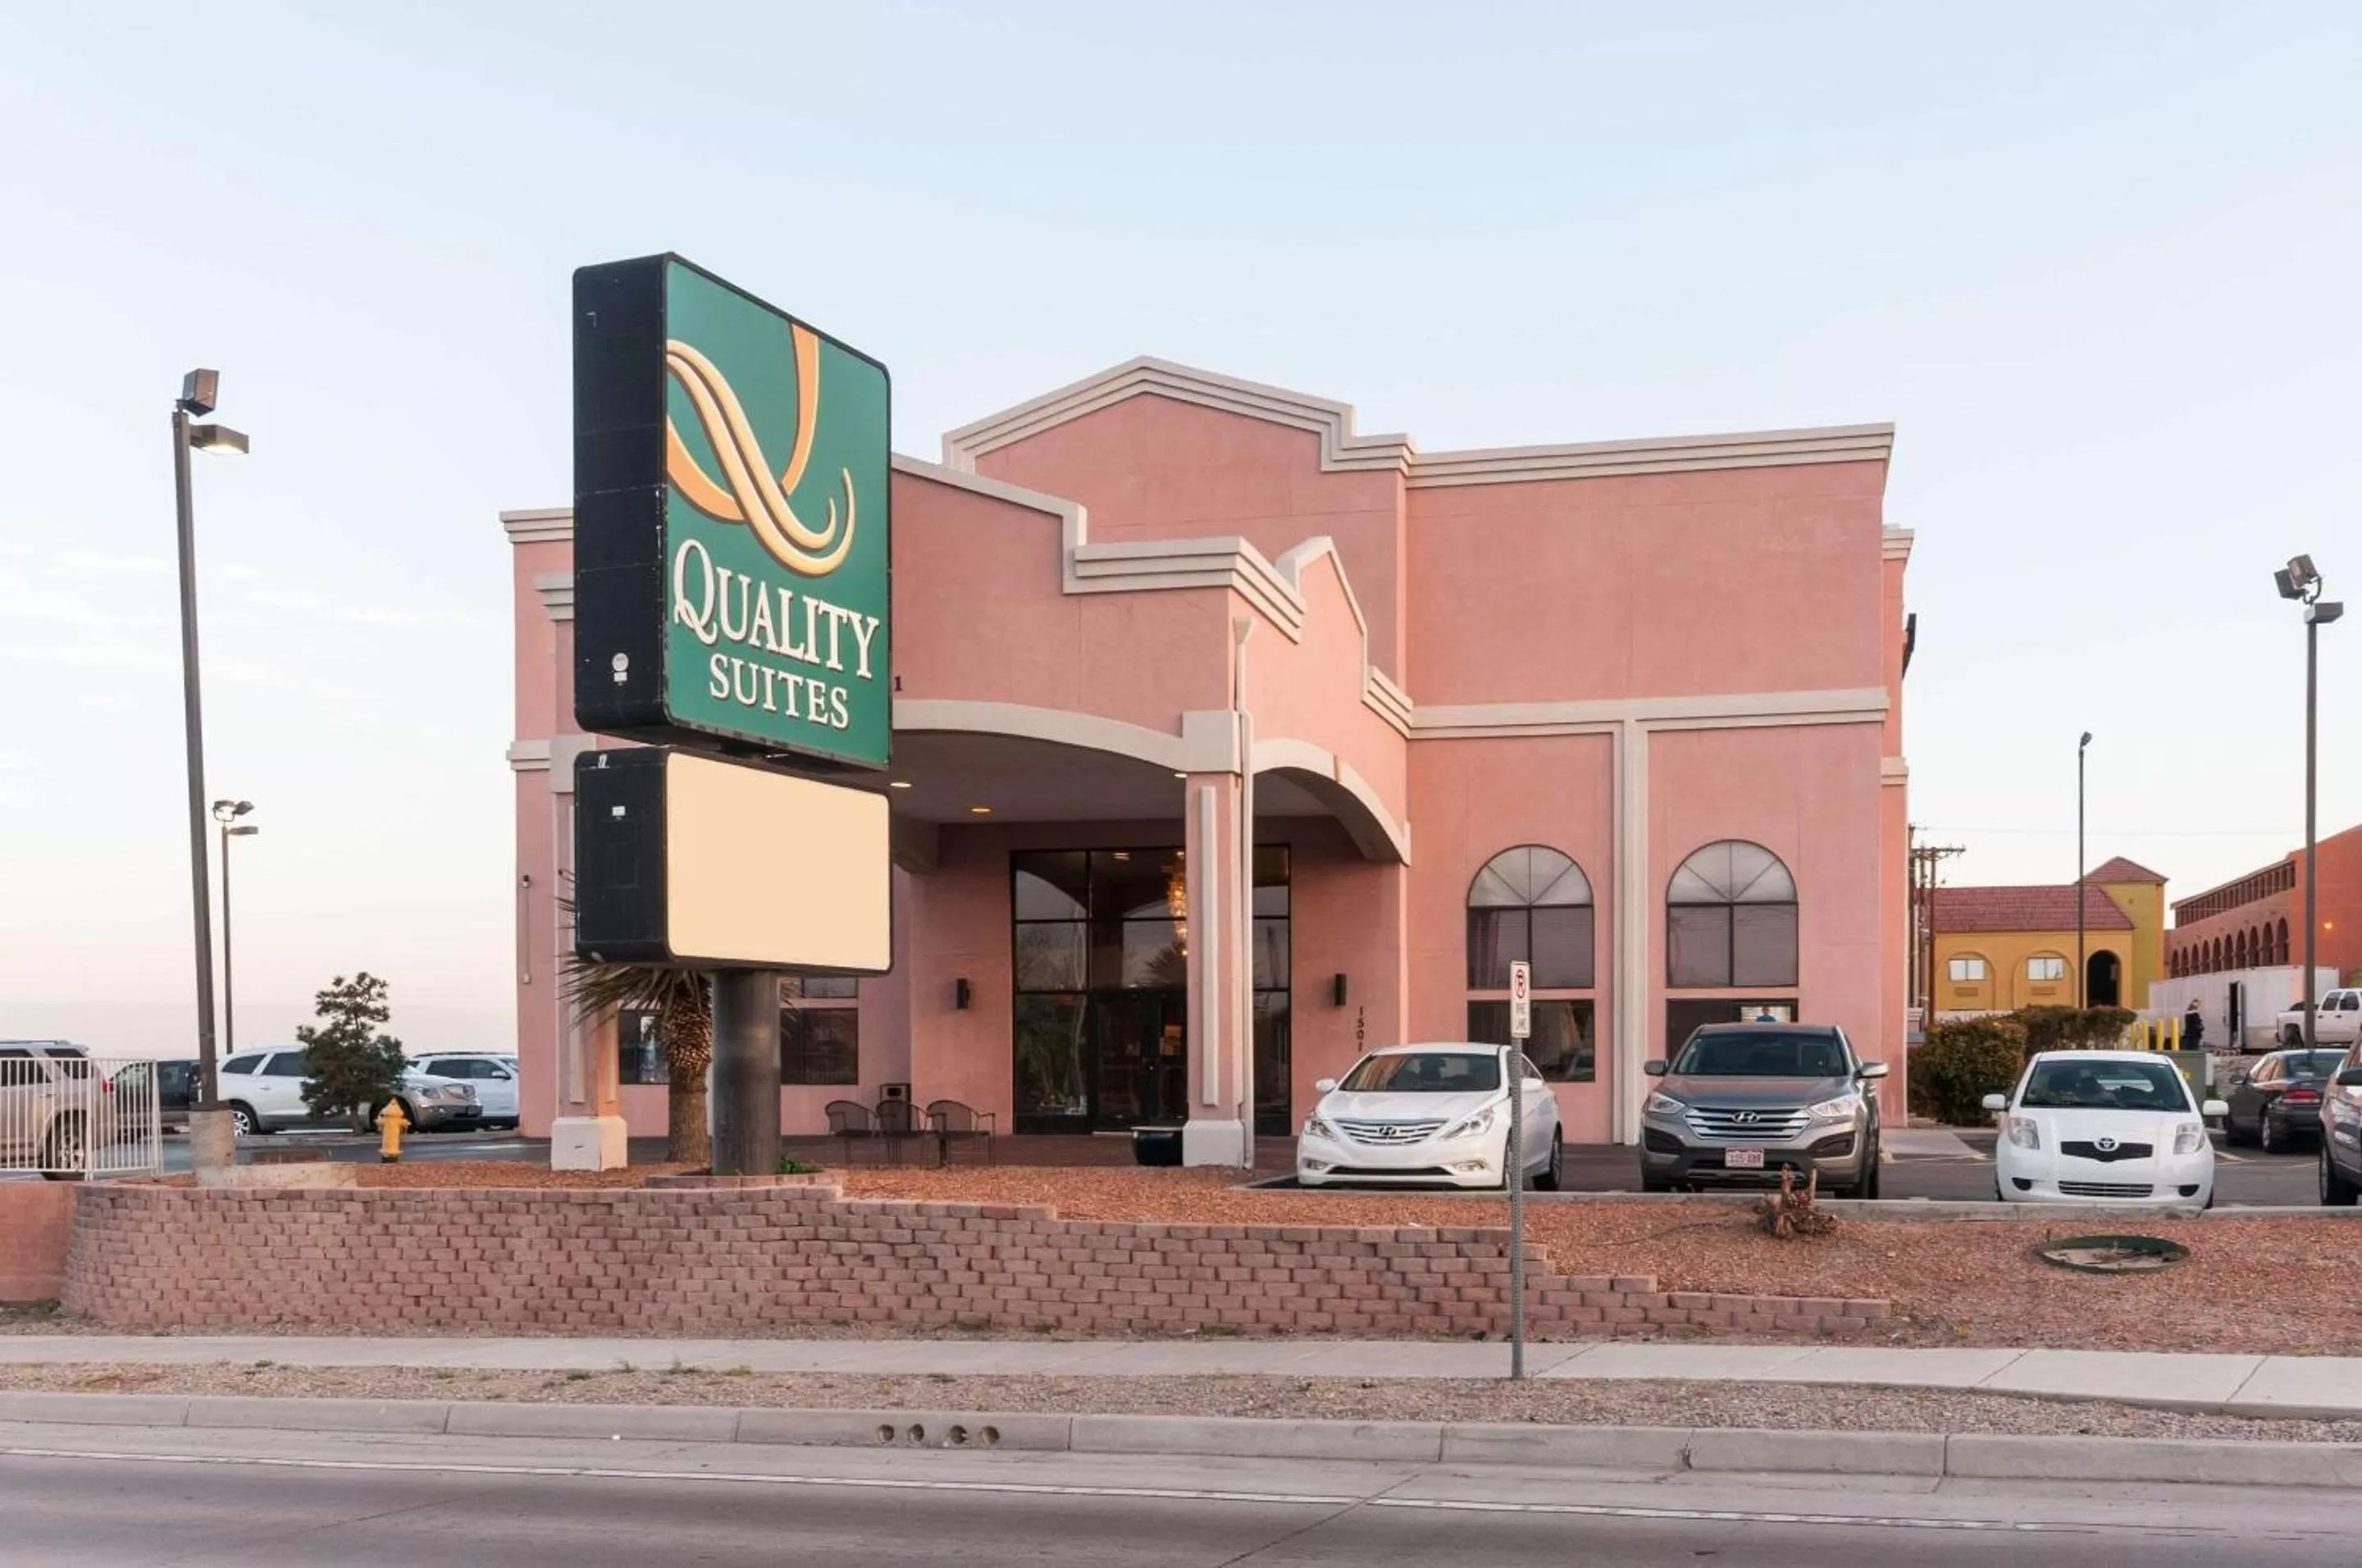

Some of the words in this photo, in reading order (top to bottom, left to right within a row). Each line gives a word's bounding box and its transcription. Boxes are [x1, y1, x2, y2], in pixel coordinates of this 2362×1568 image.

[674, 538, 880, 680] QUALITY
[709, 652, 850, 730] SUITES
[1357, 1006, 1365, 1052] 1501
